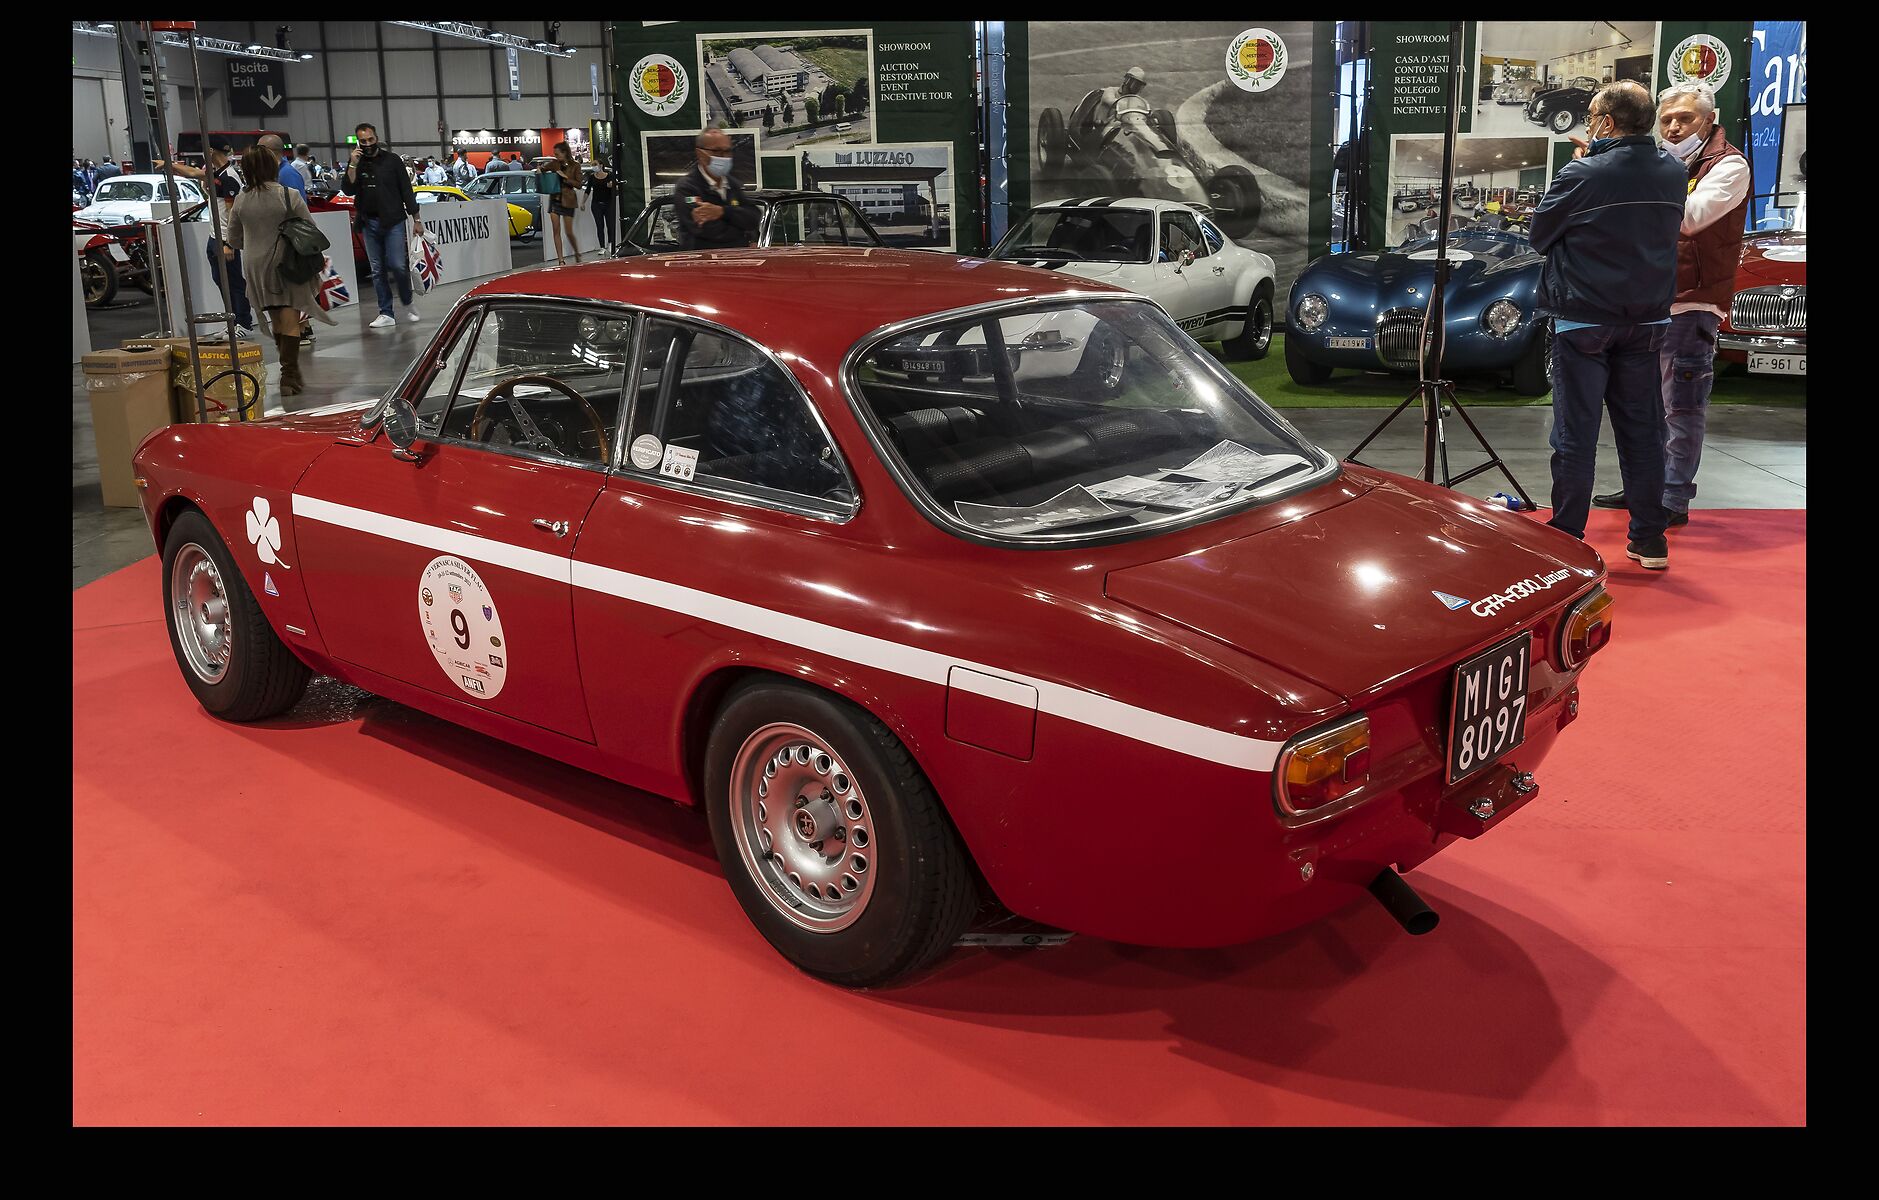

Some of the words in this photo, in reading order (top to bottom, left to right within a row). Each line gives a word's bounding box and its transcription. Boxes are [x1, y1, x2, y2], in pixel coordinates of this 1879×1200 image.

[1396, 34, 1450, 44] SHOWROOM
[878, 42, 931, 52] SHOWROOM
[1395, 55, 1420, 64] CASA
[230, 61, 269, 74] Uscita
[879, 62, 919, 72] AUCTION
[1394, 65, 1426, 74] CONTO
[1428, 64, 1467, 73] VENTA
[232, 76, 256, 88] Exit
[880, 72, 940, 82] RESTORATION
[1394, 75, 1438, 84] RESTAURI
[880, 83, 909, 92] EVENT
[1394, 85, 1440, 94] NOLEGGIO
[880, 93, 928, 102] INCENTIVE
[928, 91, 953, 100] TOUR
[1393, 96, 1426, 105] EVENTI
[1393, 106, 1441, 115] INCENTIVE
[1442, 105, 1467, 114] TR
[452, 136, 497, 146] STORANTE
[497, 136, 512, 145] DEI
[513, 135, 541, 145] PILOTI
[855, 151, 915, 165] LUZZAGO
[198, 352, 230, 360] LASTICA
[1749, 358, 1791, 370] AF-961
[431, 559, 454, 571] VERNASCA
[453, 560, 471, 577] SILVER
[450, 608, 471, 650] 9
[1458, 694, 1526, 771] 8097
